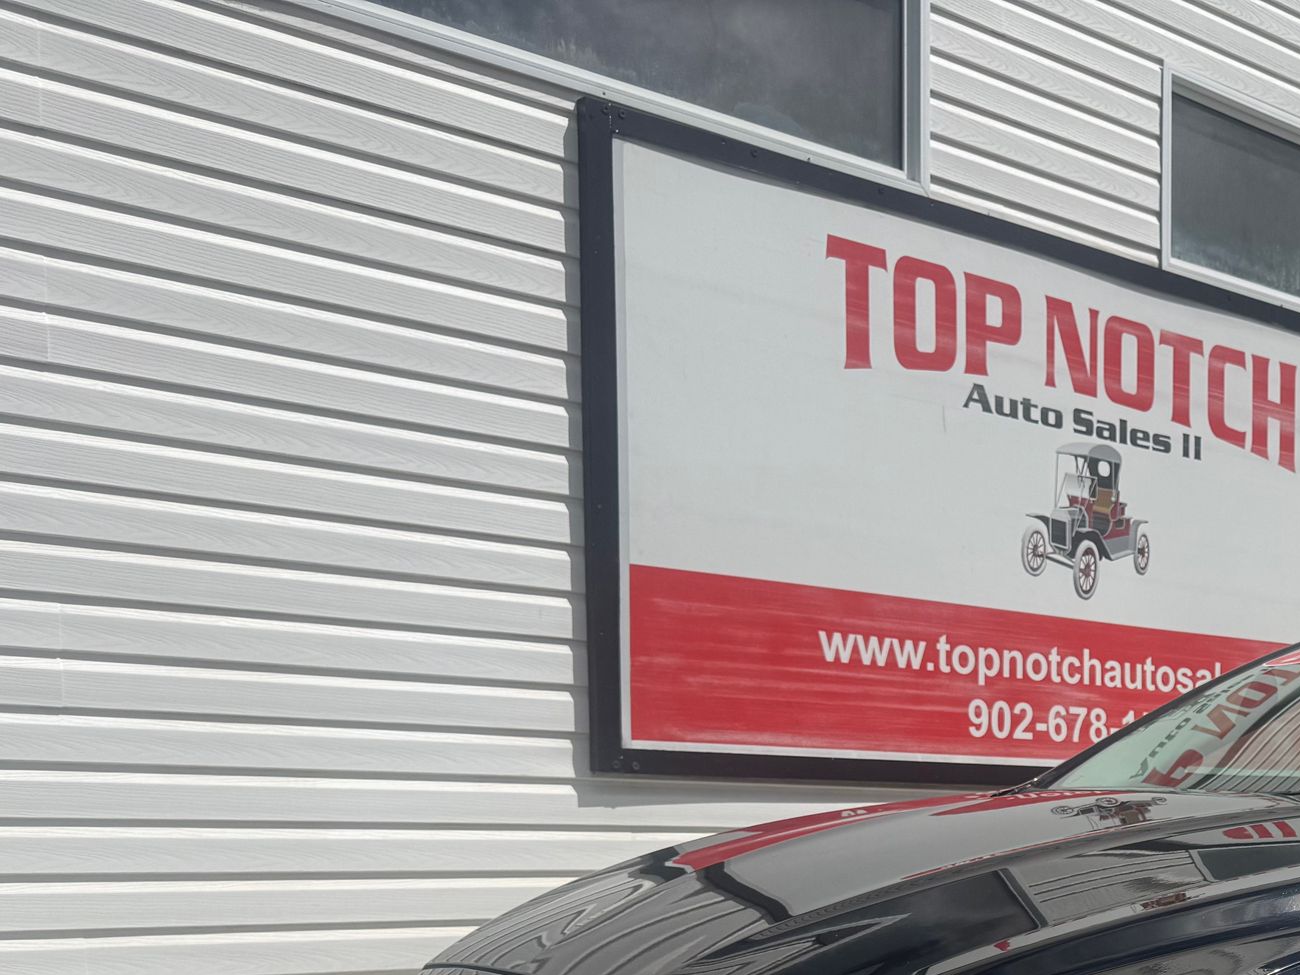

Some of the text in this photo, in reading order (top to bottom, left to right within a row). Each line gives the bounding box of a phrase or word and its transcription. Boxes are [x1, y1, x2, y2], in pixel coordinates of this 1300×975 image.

[826, 233, 1298, 474] TOP NOTCH
[962, 382, 1063, 430] Auto
[1073, 407, 1172, 455] Sales
